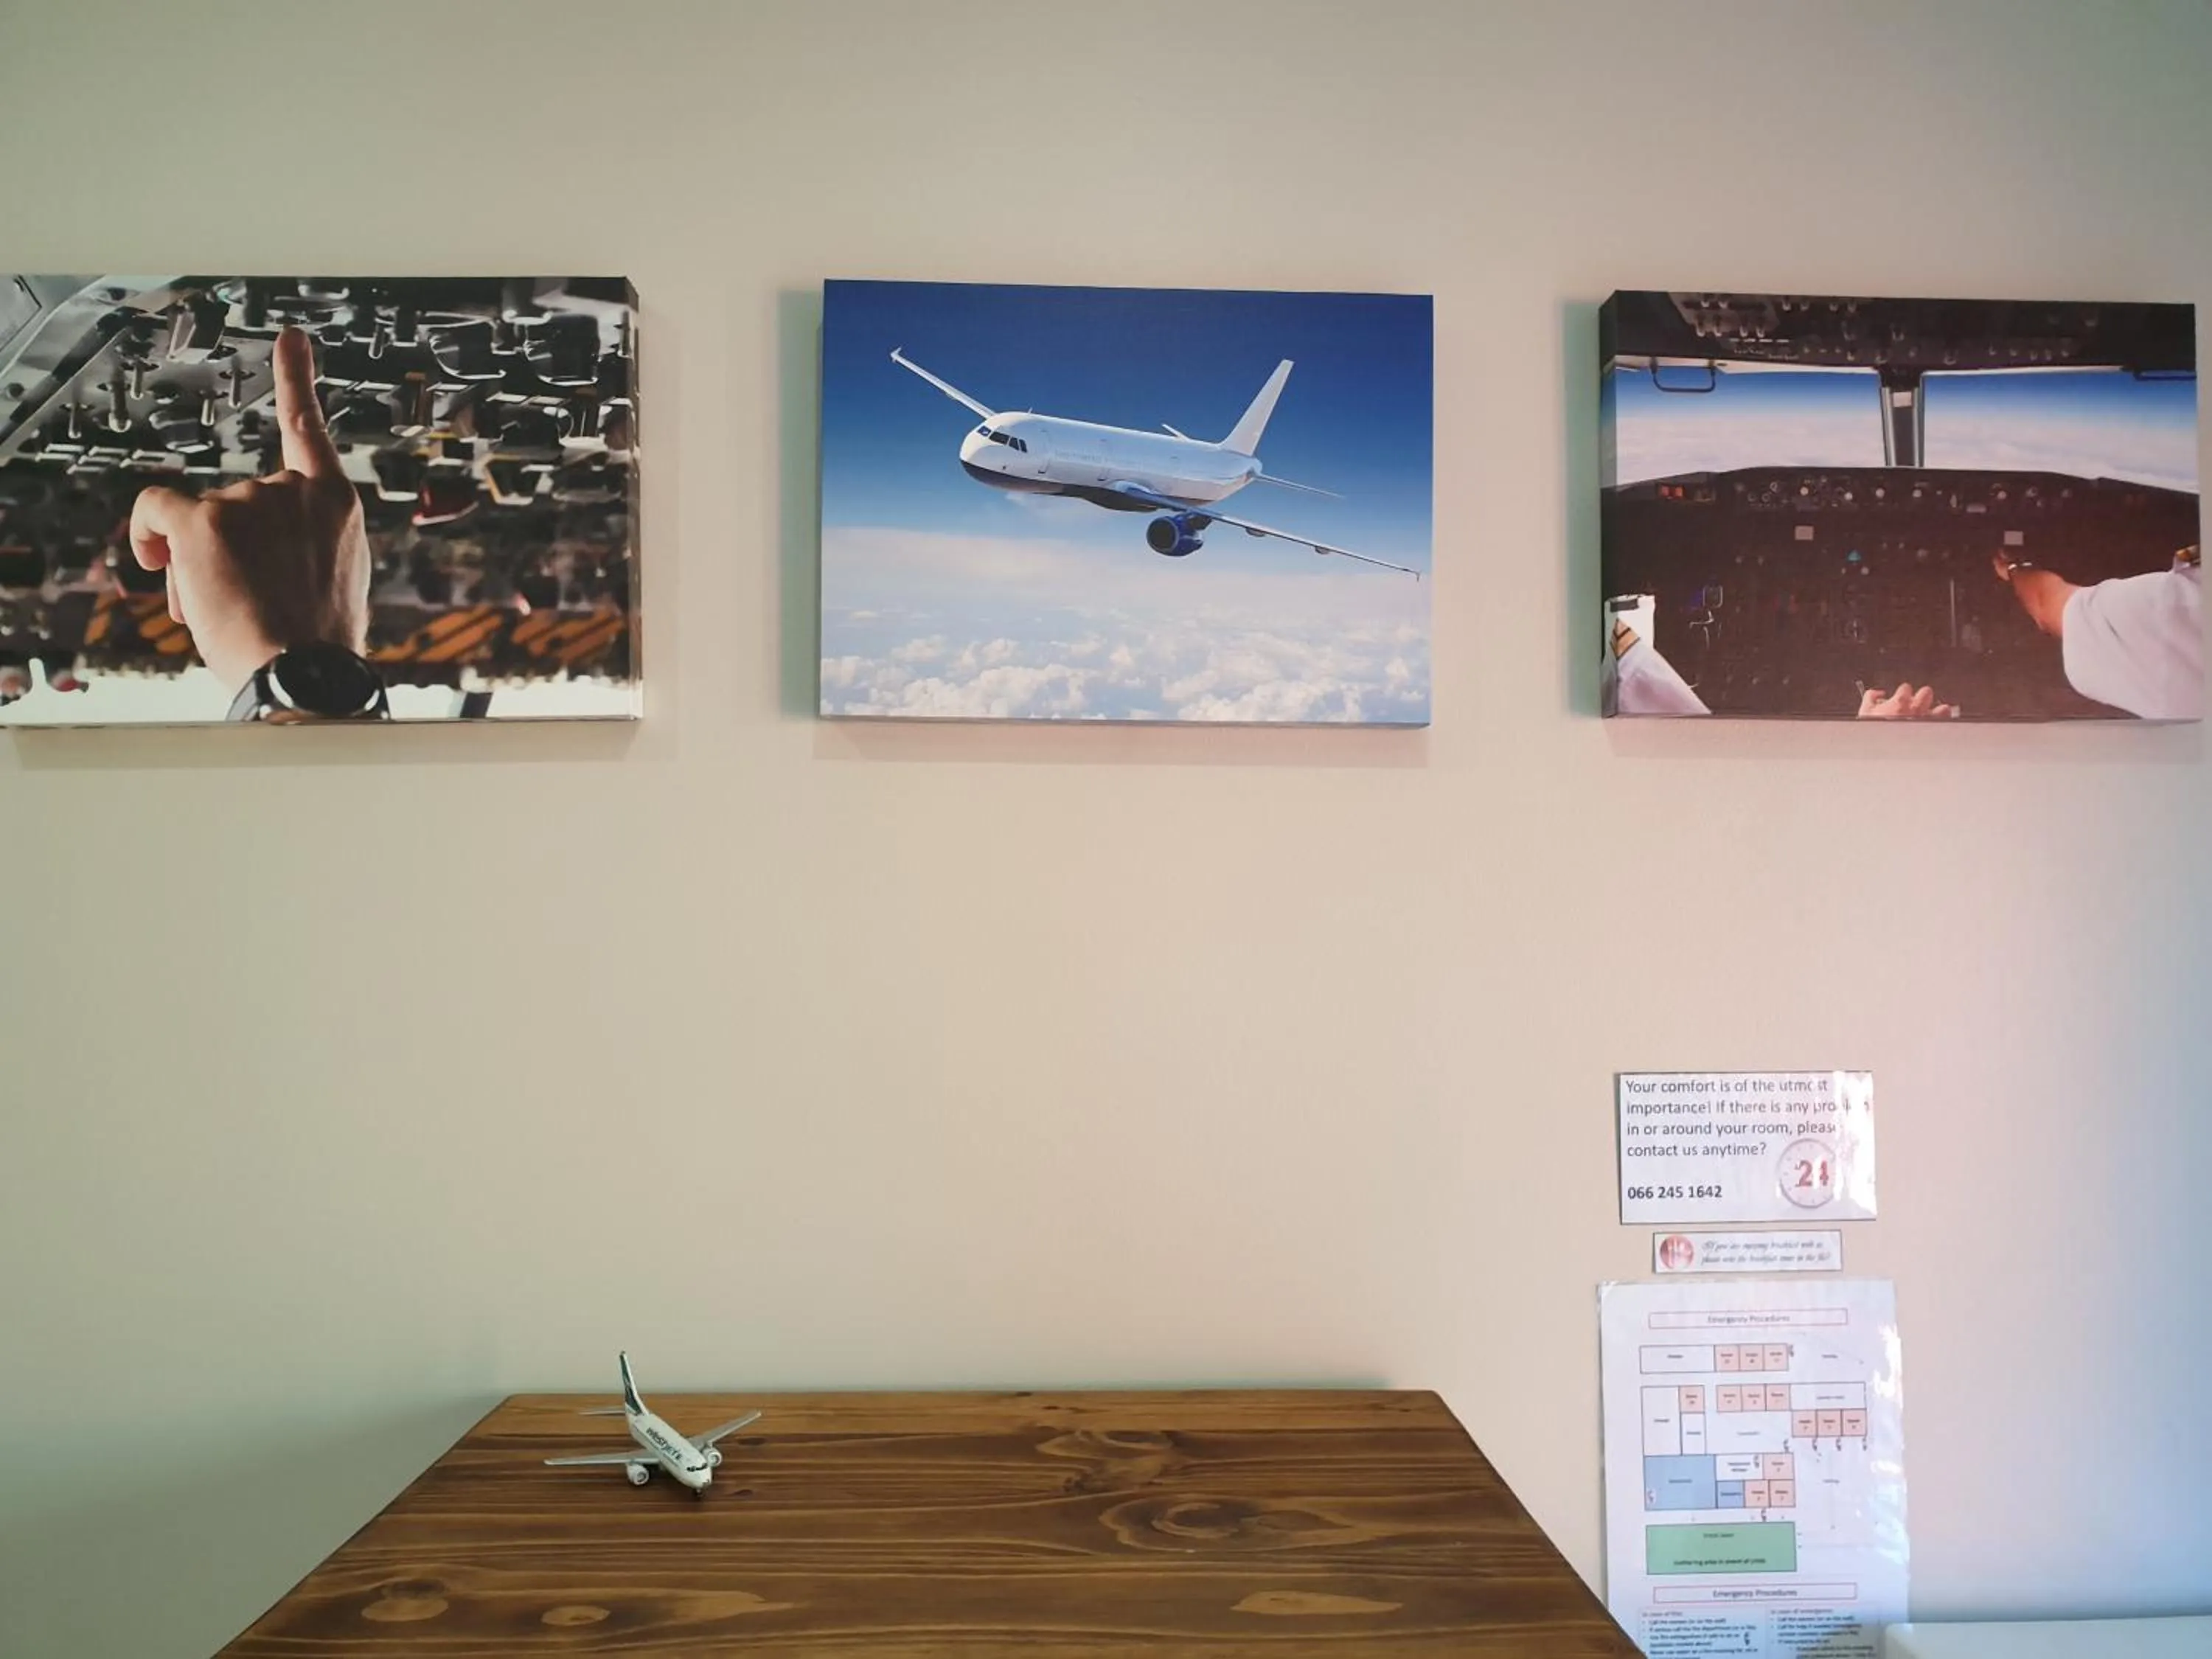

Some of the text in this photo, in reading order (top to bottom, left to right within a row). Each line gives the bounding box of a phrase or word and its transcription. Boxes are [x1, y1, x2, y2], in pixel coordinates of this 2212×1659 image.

[1626, 1079, 1657, 1093] Your
[1661, 1079, 1716, 1093] comfort
[1720, 1079, 1731, 1092] is
[1734, 1079, 1748, 1092] of
[1753, 1079, 1775, 1092] the
[1627, 1100, 1711, 1116] importance!
[1717, 1099, 1725, 1113] If
[1729, 1099, 1767, 1113] there
[1770, 1099, 1781, 1113] is
[1785, 1101, 1809, 1115] any
[1627, 1121, 1639, 1135] in
[1644, 1124, 1658, 1135] or
[1663, 1121, 1711, 1135] around
[1716, 1123, 1748, 1137] your
[1752, 1122, 1792, 1136] room,
[1627, 1141, 1767, 1158] contact us anytime?
[1627, 1184, 1722, 1199] 066 245 1642
